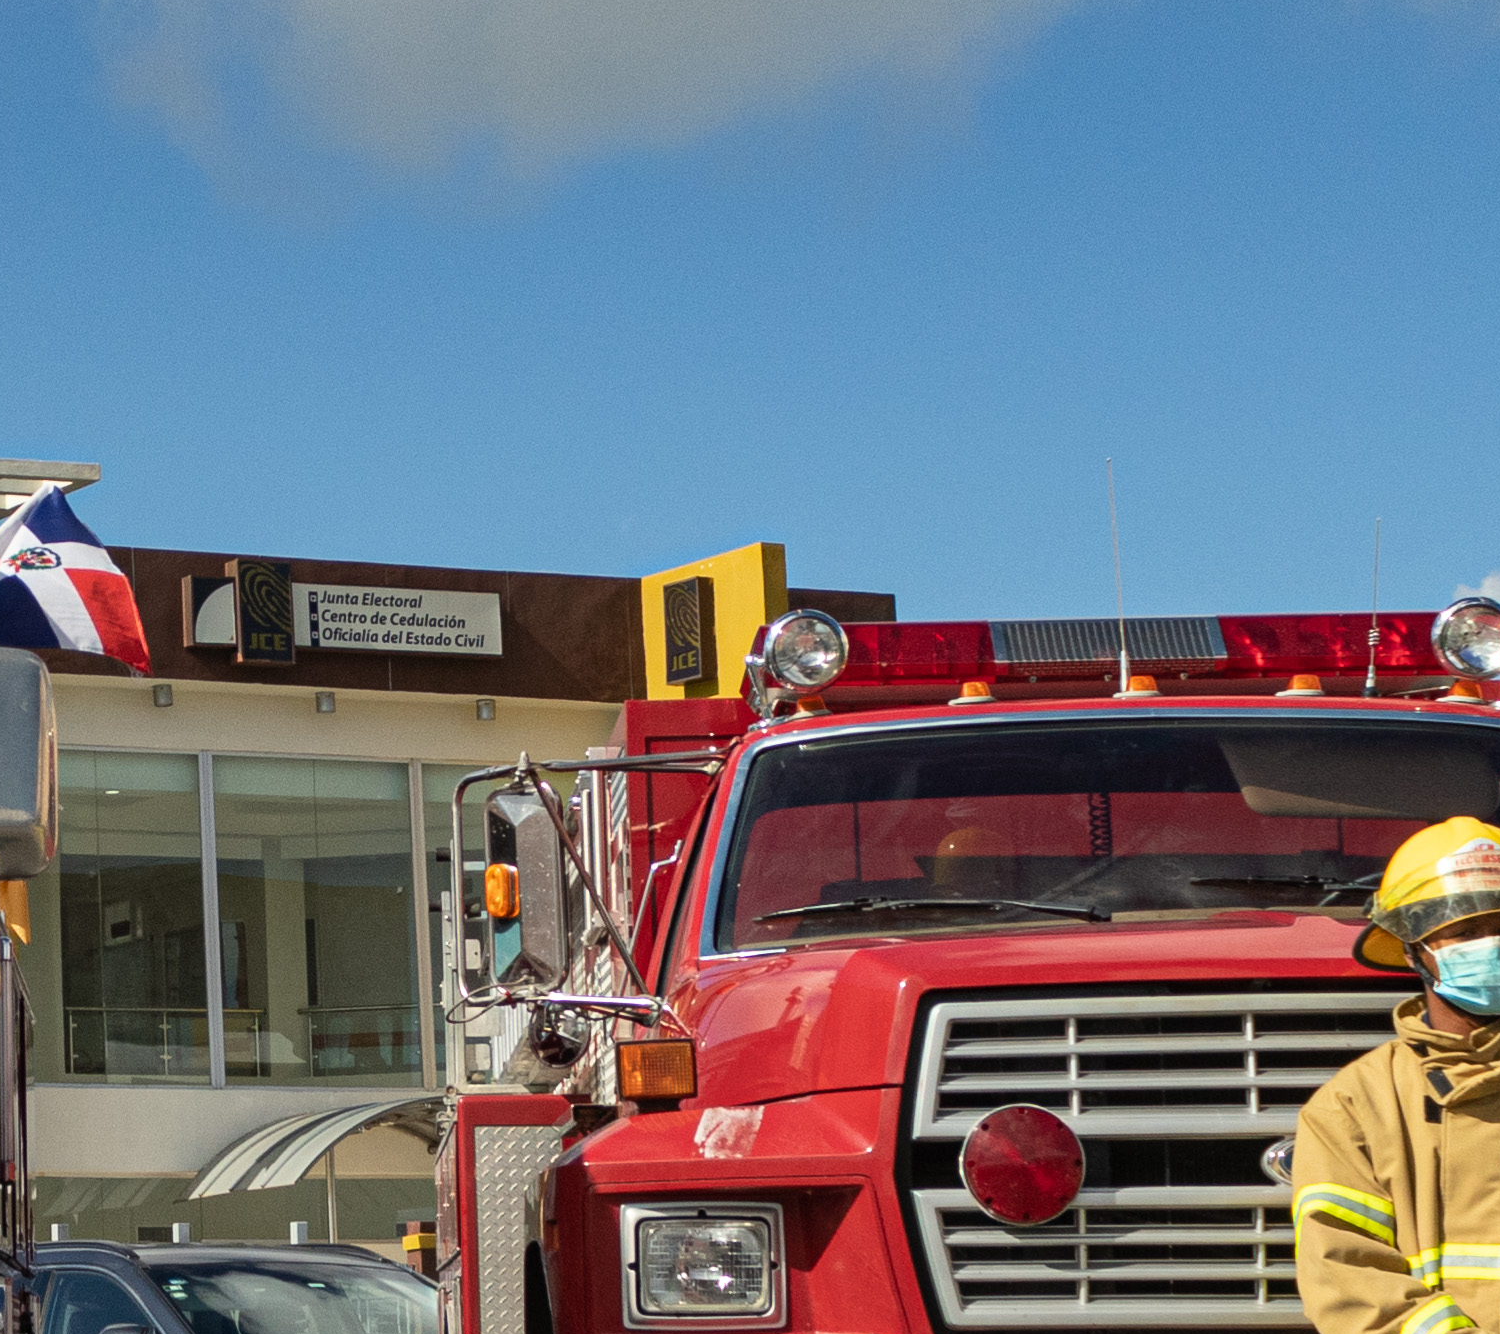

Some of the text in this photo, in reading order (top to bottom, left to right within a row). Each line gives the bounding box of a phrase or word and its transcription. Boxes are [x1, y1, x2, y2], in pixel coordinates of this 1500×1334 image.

[319, 590, 423, 609] Junta Electoral
[321, 609, 466, 629] Centro de Cedulación
[249, 632, 288, 651] JCE
[322, 627, 485, 648] Oficialía del Estado Civil
[671, 650, 697, 672] JCE
